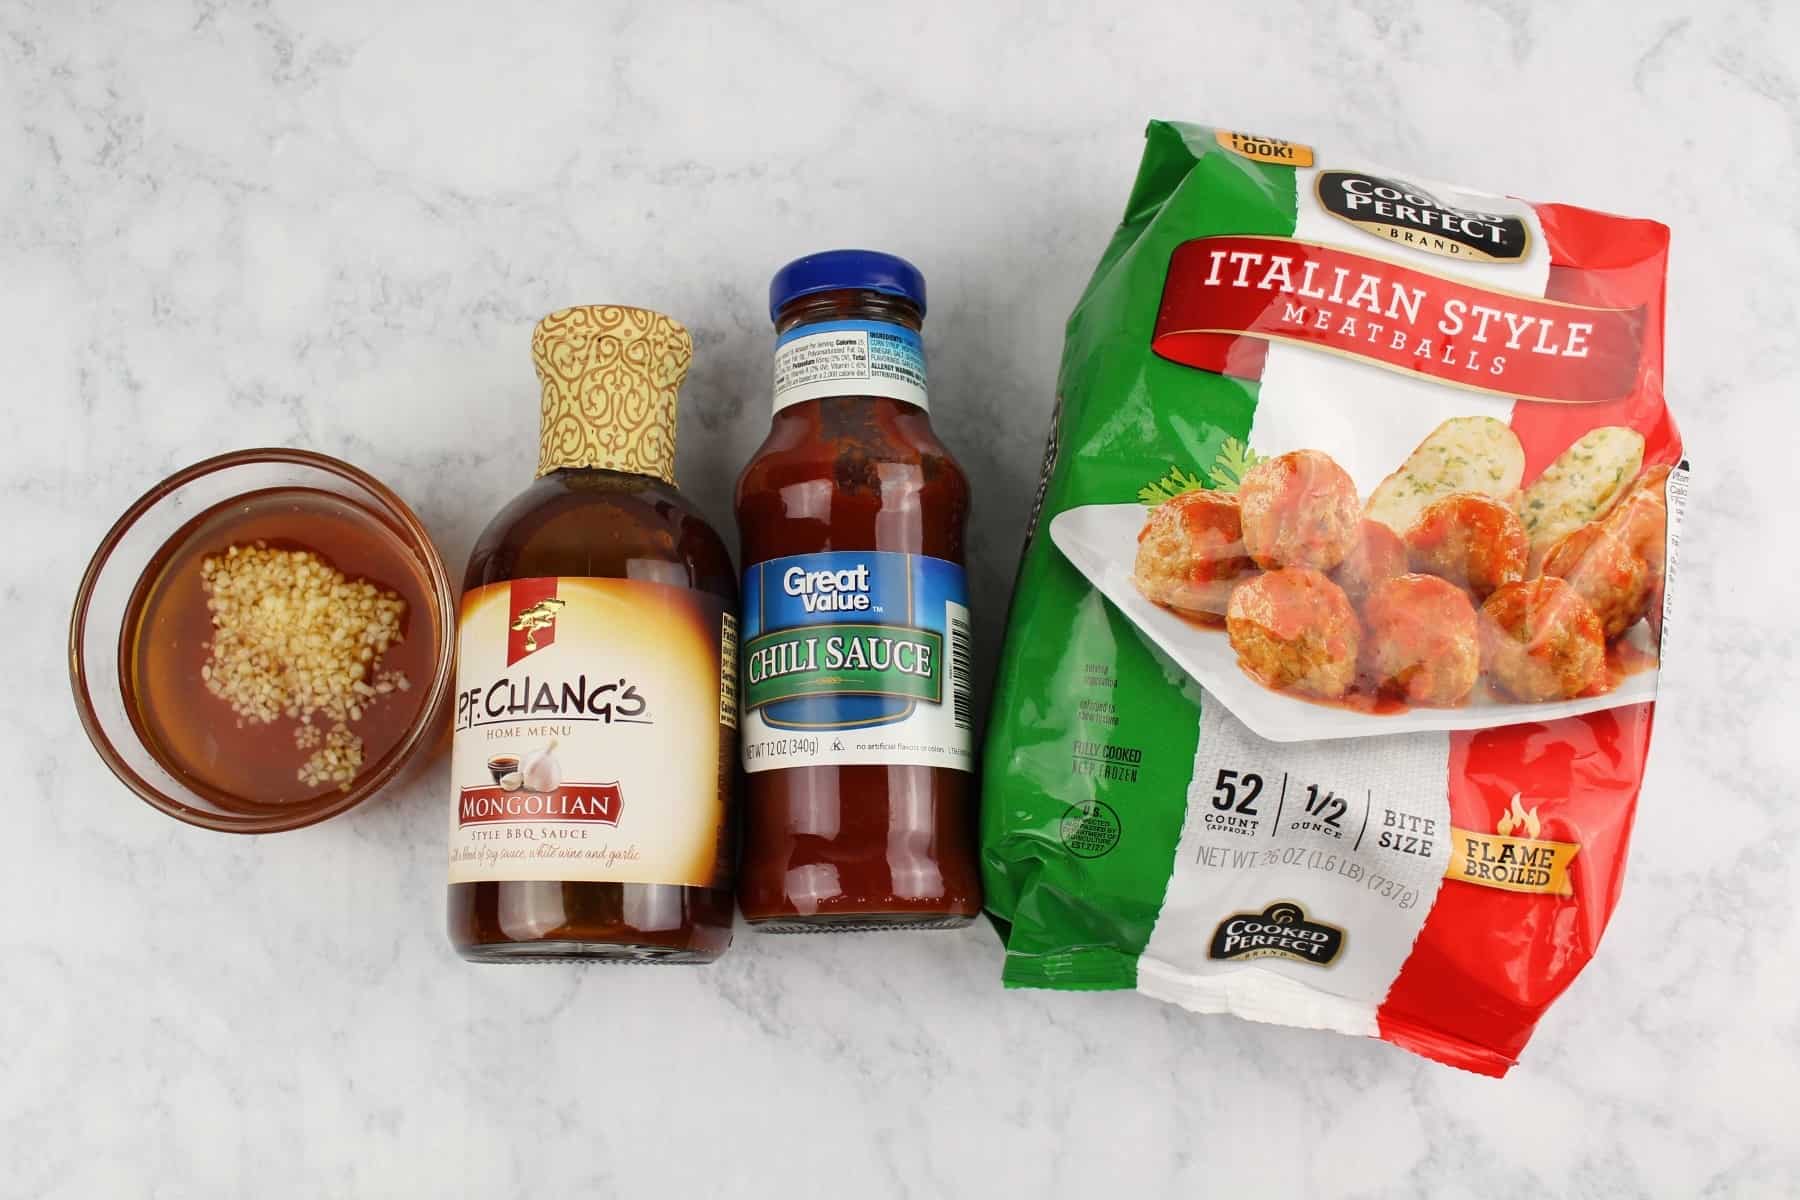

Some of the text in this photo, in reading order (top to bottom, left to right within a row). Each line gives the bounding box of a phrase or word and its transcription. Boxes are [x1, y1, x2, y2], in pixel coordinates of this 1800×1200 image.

[1231, 140, 1294, 159] LOOK!
[1346, 193, 1505, 244] PERFECT
[1390, 228, 1460, 254] BRAND
[1203, 250, 1593, 359] ITALIAN STYLE
[1282, 303, 1508, 375] MEATBALLS
[783, 564, 870, 596] Great
[802, 591, 870, 612] Value
[750, 637, 818, 684] CHILI
[825, 636, 932, 678] SAUCE
[456, 674, 647, 727] P.F. CHANG'S
[486, 725, 572, 740] HOME MENU
[767, 741, 775, 757] 12
[776, 740, 787, 756] OZ
[789, 737, 819, 757] (340g)
[1102, 744, 1142, 764] COOKED
[1212, 769, 1264, 816] 52
[462, 795, 610, 818] MONGOLIAN
[1305, 784, 1348, 828] 1/2
[471, 828, 588, 840] STYLE BBQ SAUCE
[1204, 813, 1259, 830] COUNT
[1291, 822, 1343, 839] OUNCE
[1384, 809, 1436, 837] BITE
[585, 843, 608, 858] and
[1378, 832, 1433, 858] SIZE
[1465, 838, 1555, 870] FLAME
[1196, 846, 1233, 868] NET
[1282, 847, 1307, 867] OZ
[1307, 850, 1337, 873] (1.6
[1338, 857, 1366, 882] LB)
[1367, 873, 1420, 910] (737g)
[1464, 858, 1551, 887] BROILED
[1226, 920, 1329, 943] COOKED
[1223, 935, 1325, 956] PERFECT
